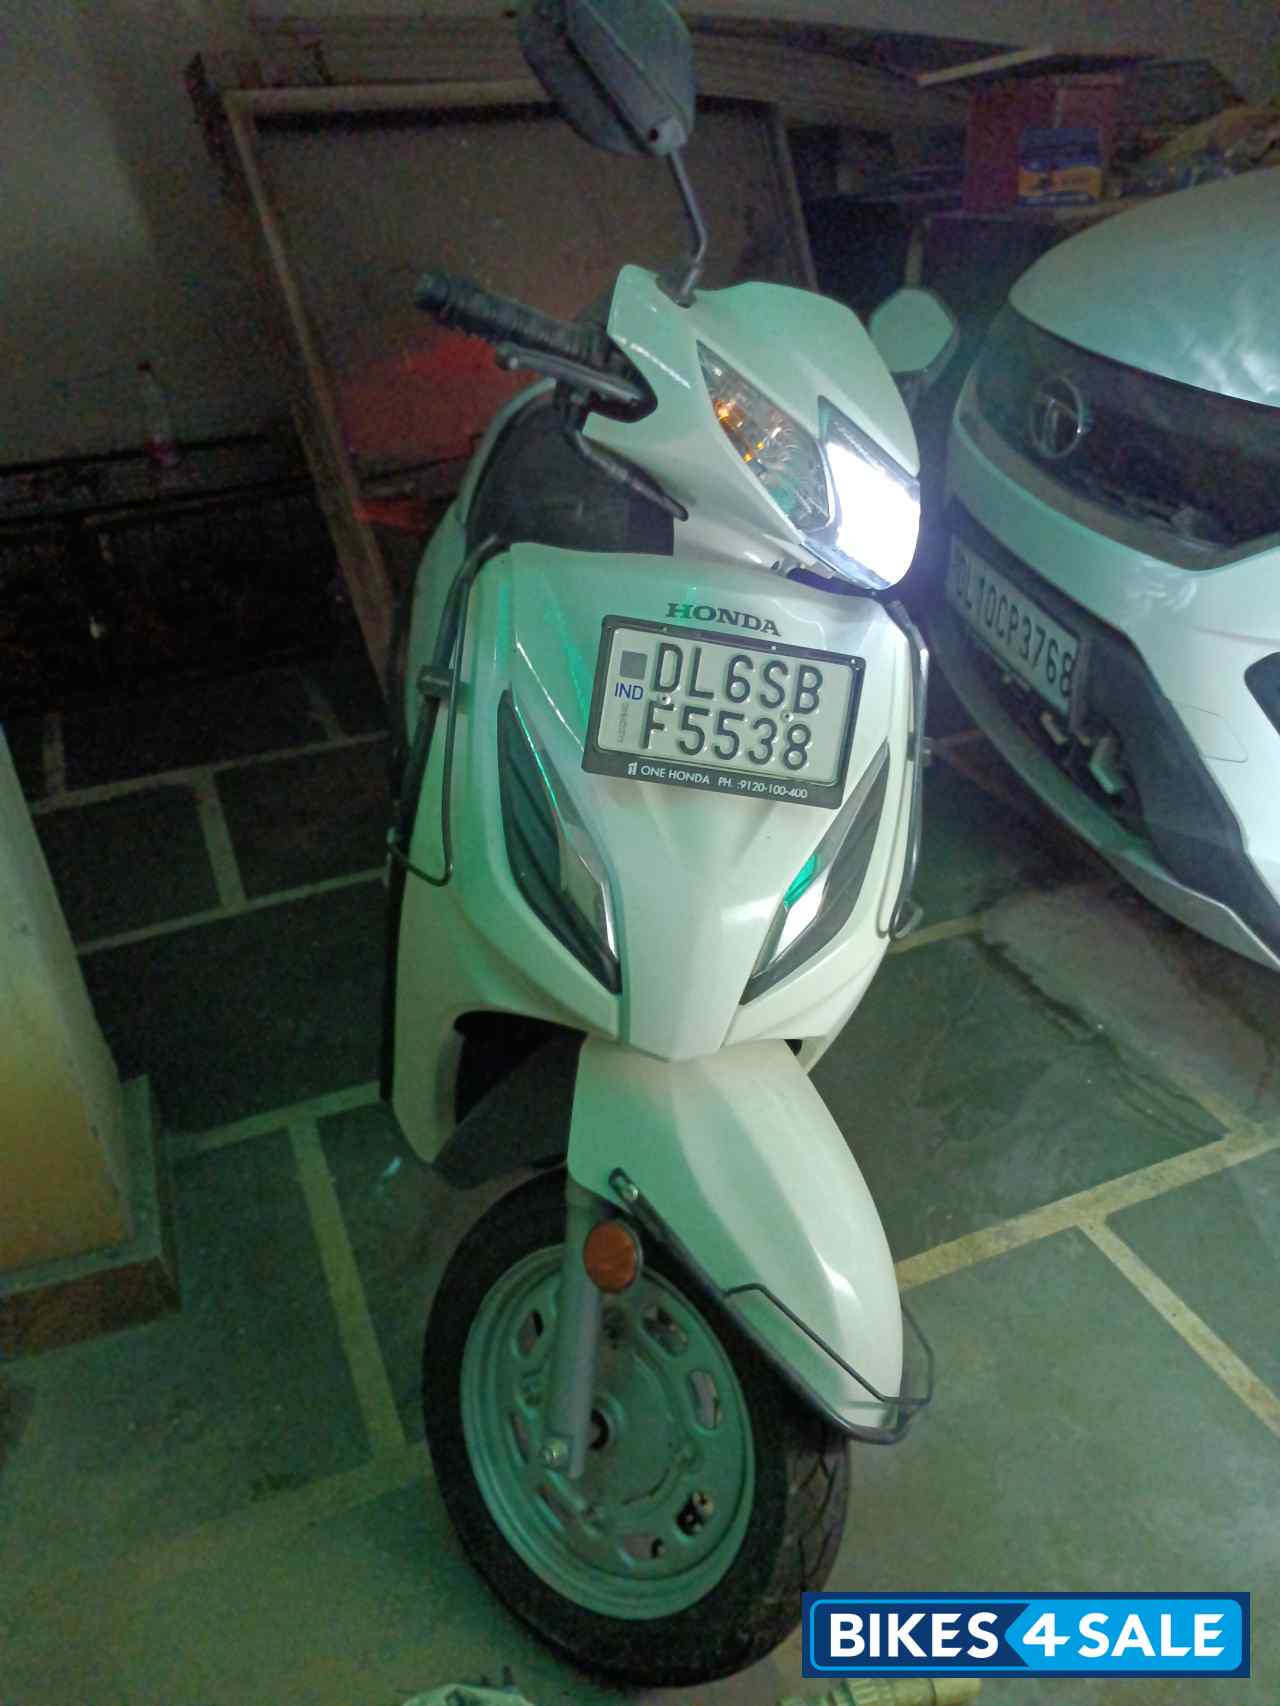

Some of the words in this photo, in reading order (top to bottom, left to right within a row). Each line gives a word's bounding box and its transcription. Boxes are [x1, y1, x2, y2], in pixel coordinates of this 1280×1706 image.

[666, 602, 782, 637] HONDA
[614, 682, 644, 700] IND
[654, 642, 824, 715] DL6SB
[640, 699, 811, 772] F5538
[640, 765, 666, 778] ONE
[668, 769, 710, 785] HONDA
